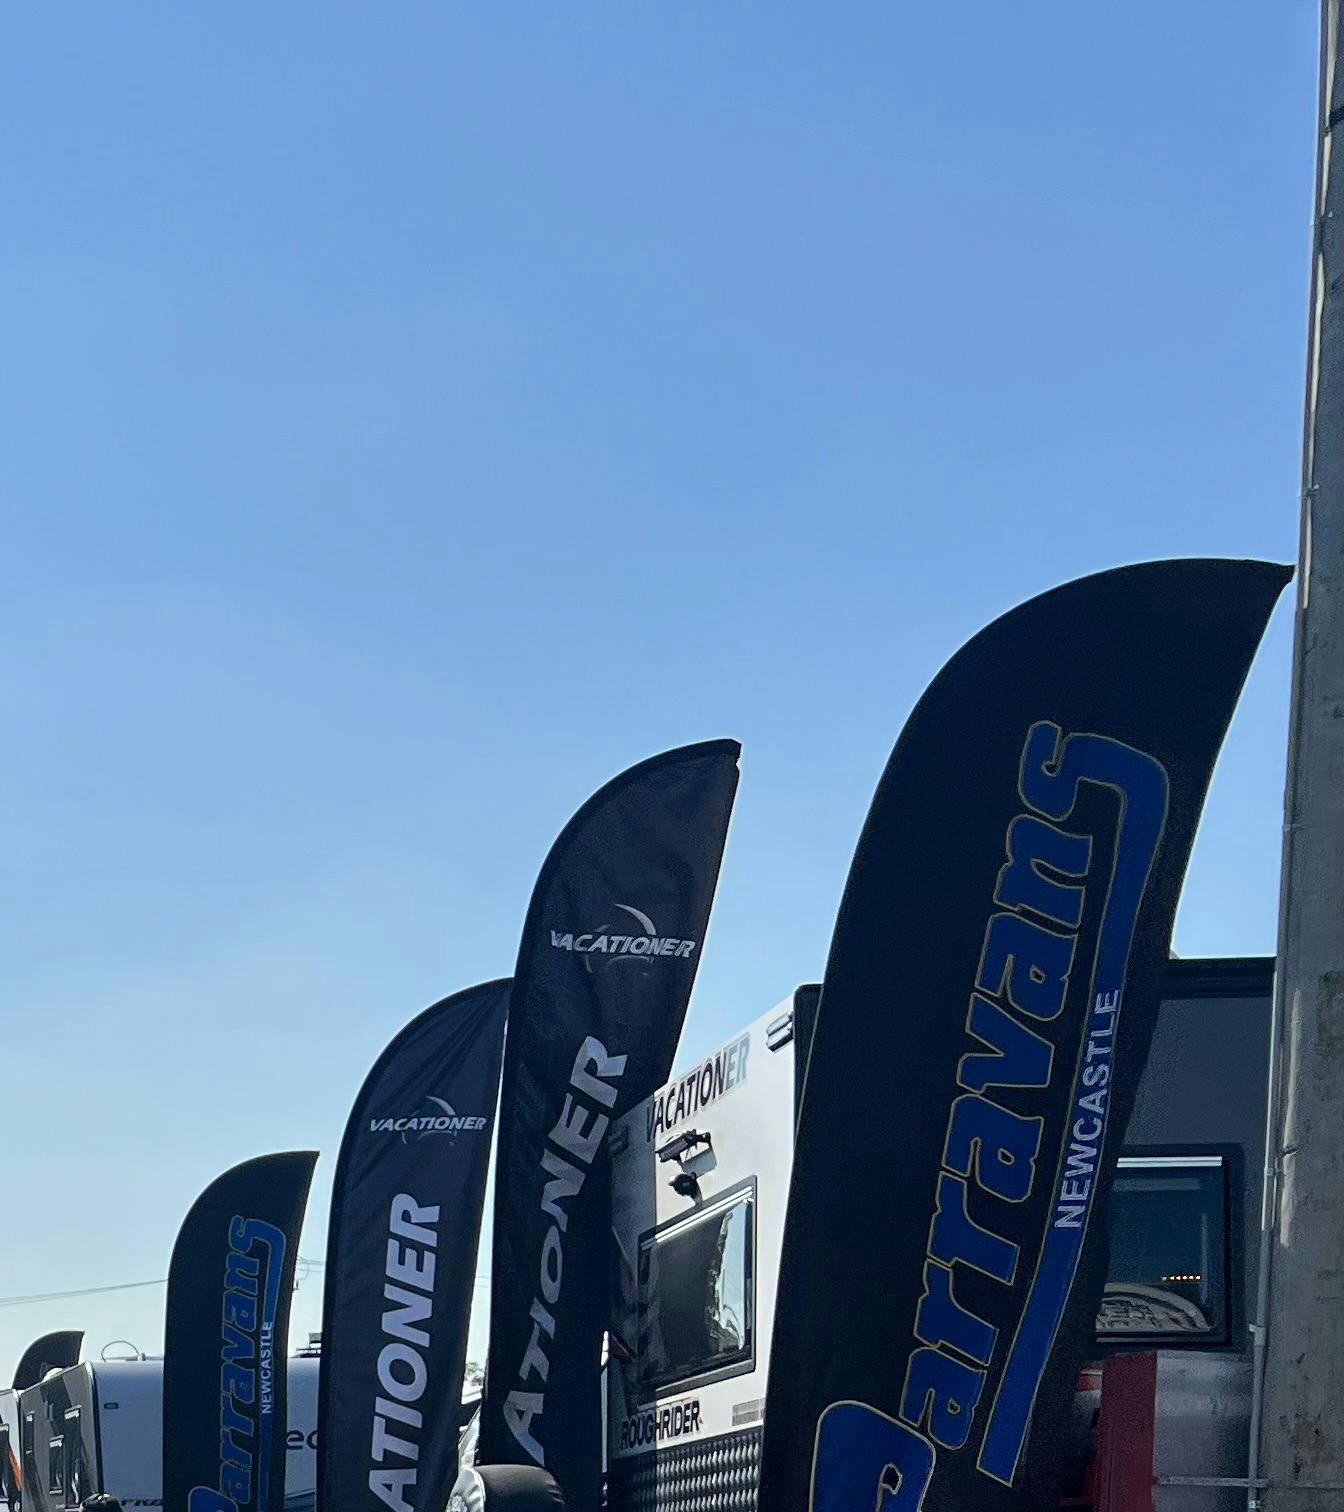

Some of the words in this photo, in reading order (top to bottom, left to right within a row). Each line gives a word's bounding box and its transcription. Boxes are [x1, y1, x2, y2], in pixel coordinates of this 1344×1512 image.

[550, 930, 696, 958] VACATIONER
[370, 1117, 487, 1131] VACATIONER
[646, 1036, 750, 1142] VACATIONER
[1056, 987, 1121, 1230] NEWCASTLE
[502, 1034, 628, 1467] ATIONER
[261, 1321, 273, 1414] NEWCASTLE
[621, 1400, 699, 1448] ROUGHRIDER
